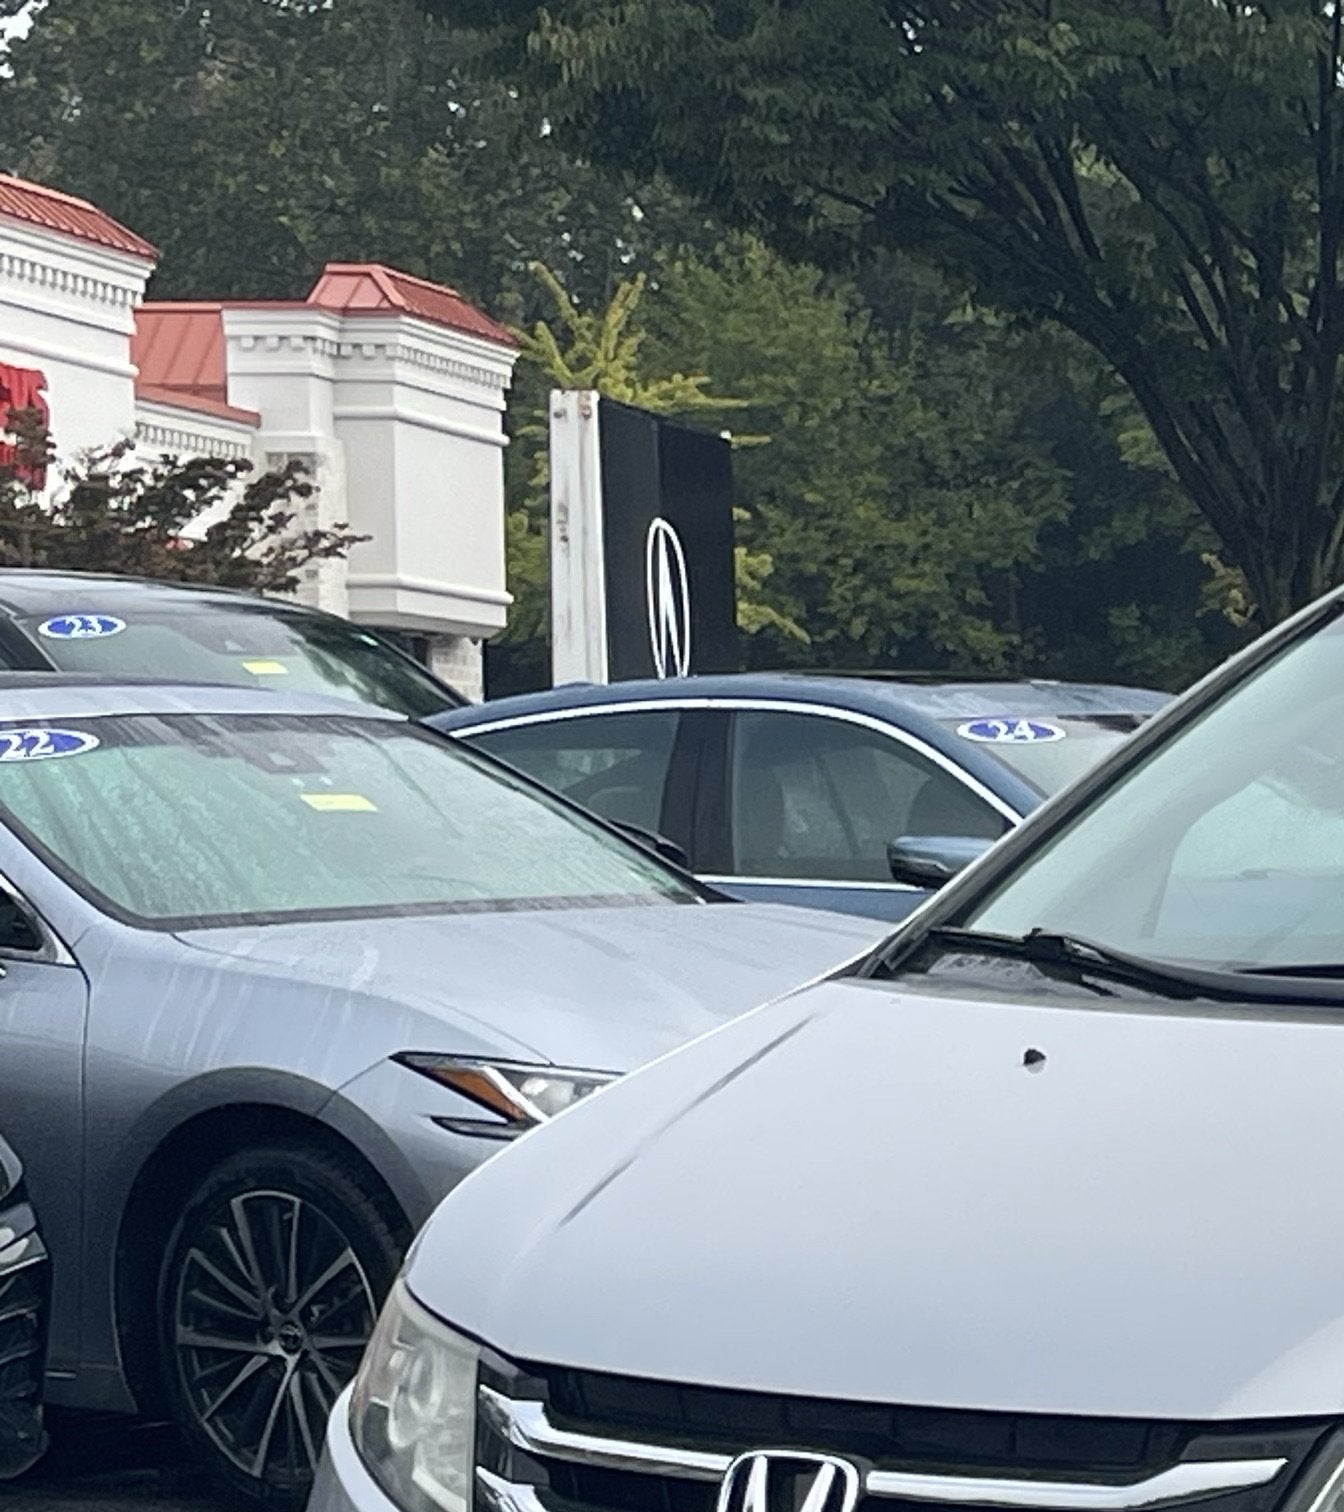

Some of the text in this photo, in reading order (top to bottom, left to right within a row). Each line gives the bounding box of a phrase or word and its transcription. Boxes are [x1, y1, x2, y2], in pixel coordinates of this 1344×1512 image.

[64, 615, 102, 636] 23
[987, 719, 1036, 740] 24
[0, 730, 55, 759] 22
